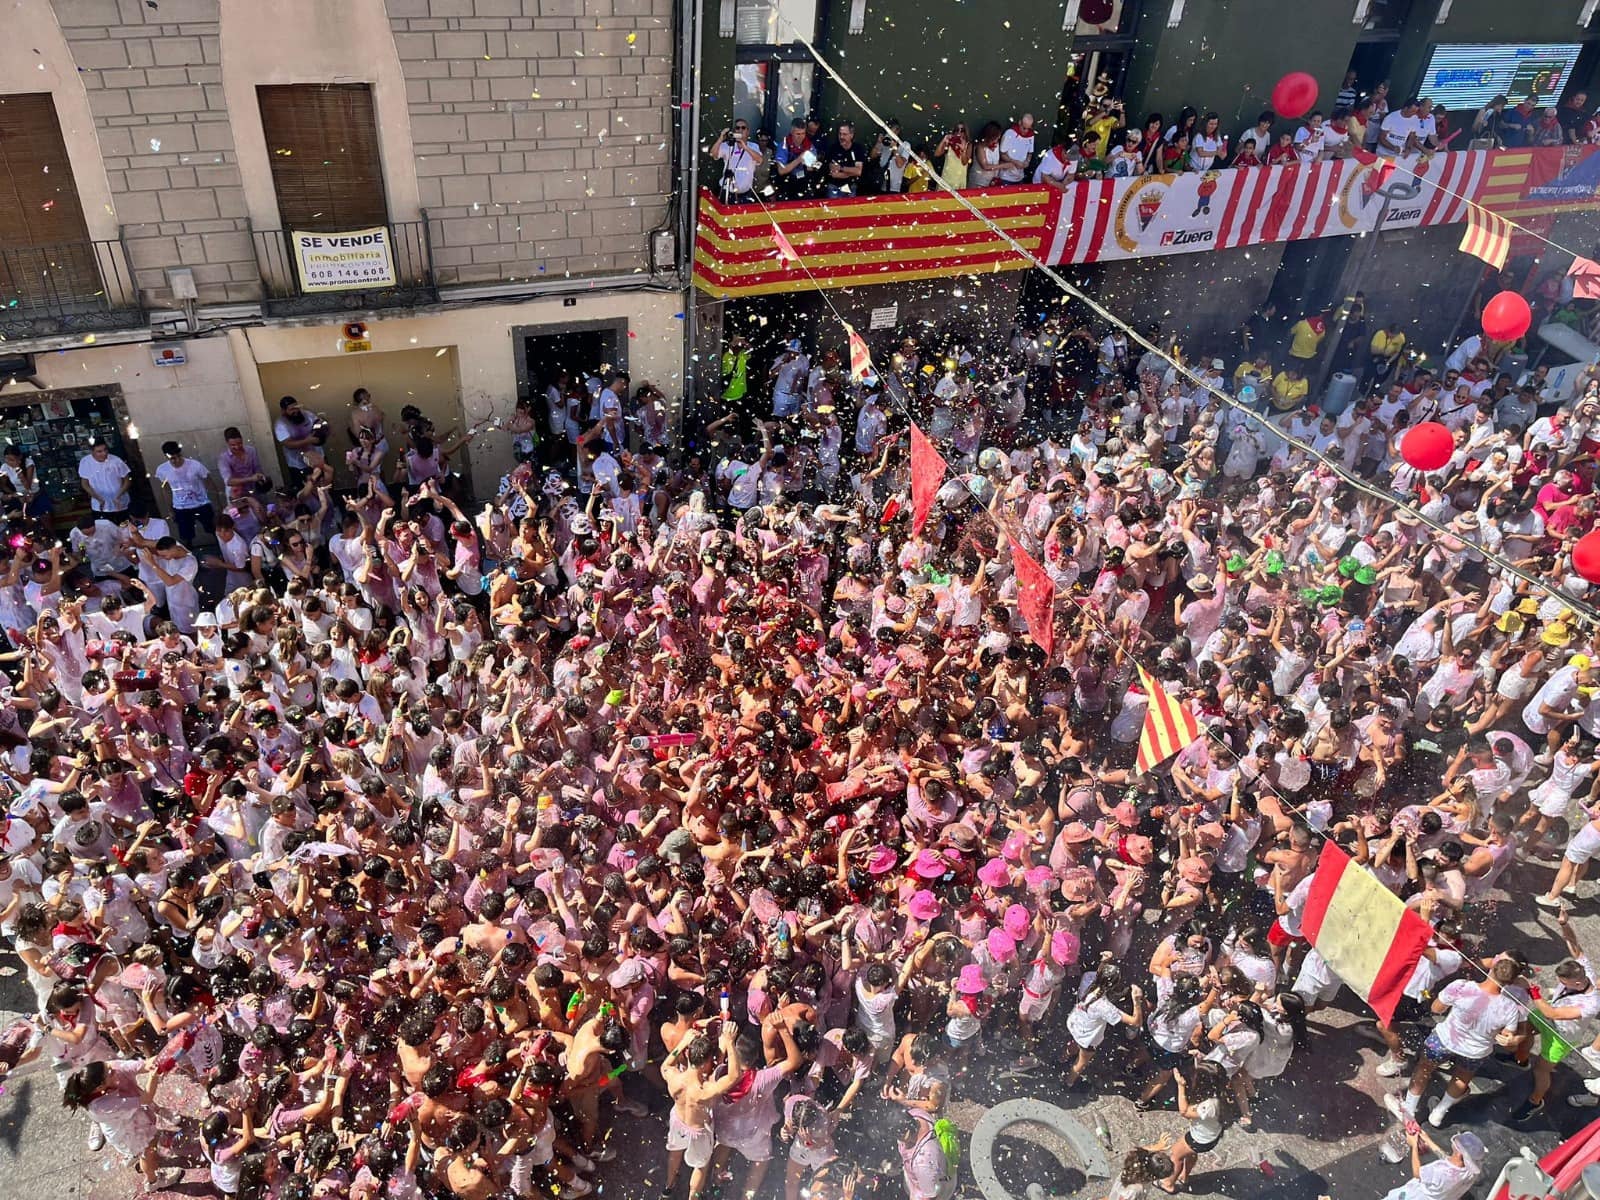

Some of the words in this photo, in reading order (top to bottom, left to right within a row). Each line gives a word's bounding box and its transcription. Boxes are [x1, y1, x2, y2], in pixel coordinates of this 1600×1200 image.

[1386, 207, 1421, 222] Zuera
[301, 237, 322, 248] SE
[327, 233, 384, 247] VENDE
[1173, 230, 1212, 245] Zuera
[310, 252, 381, 261] inmobiliaria
[311, 271, 333, 279] 608
[338, 269, 359, 277] 146
[308, 277, 390, 286] www.promocontrol.es
